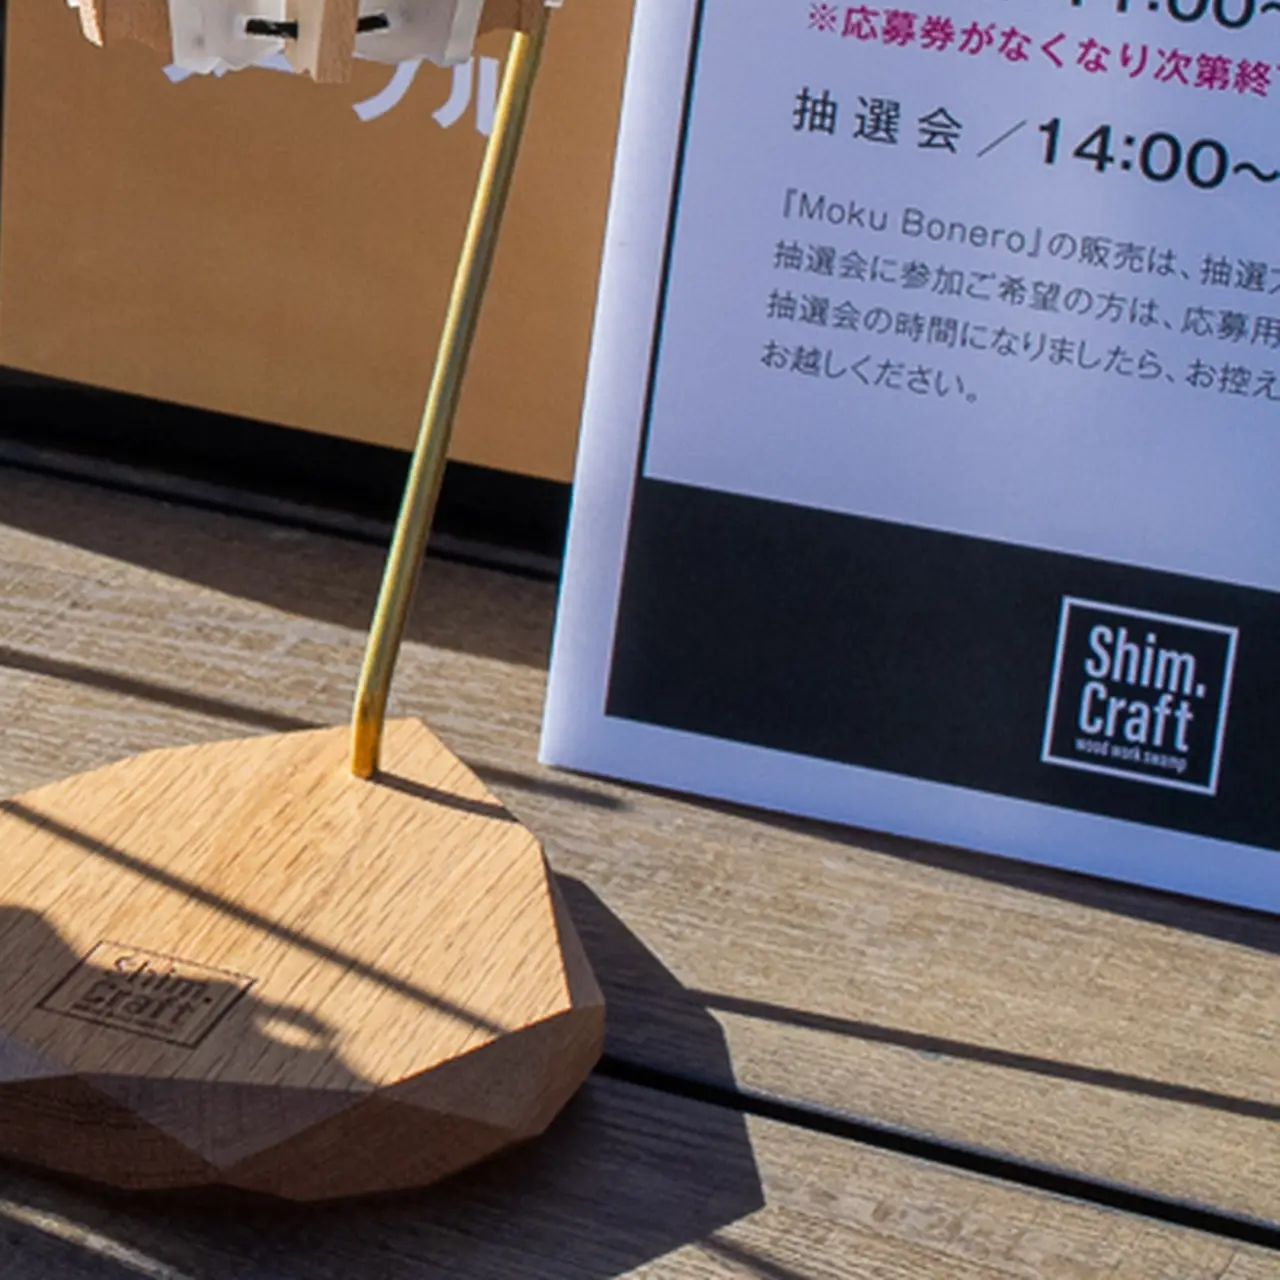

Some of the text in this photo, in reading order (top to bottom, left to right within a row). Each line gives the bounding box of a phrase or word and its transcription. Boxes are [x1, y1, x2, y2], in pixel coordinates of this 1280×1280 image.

[808, 2, 1280, 98] ※応募券がなくなり次第終
[760, 340, 979, 404] お越しください。
[1084, 623, 1207, 699] Shim.
[1077, 680, 1194, 753] Craft
